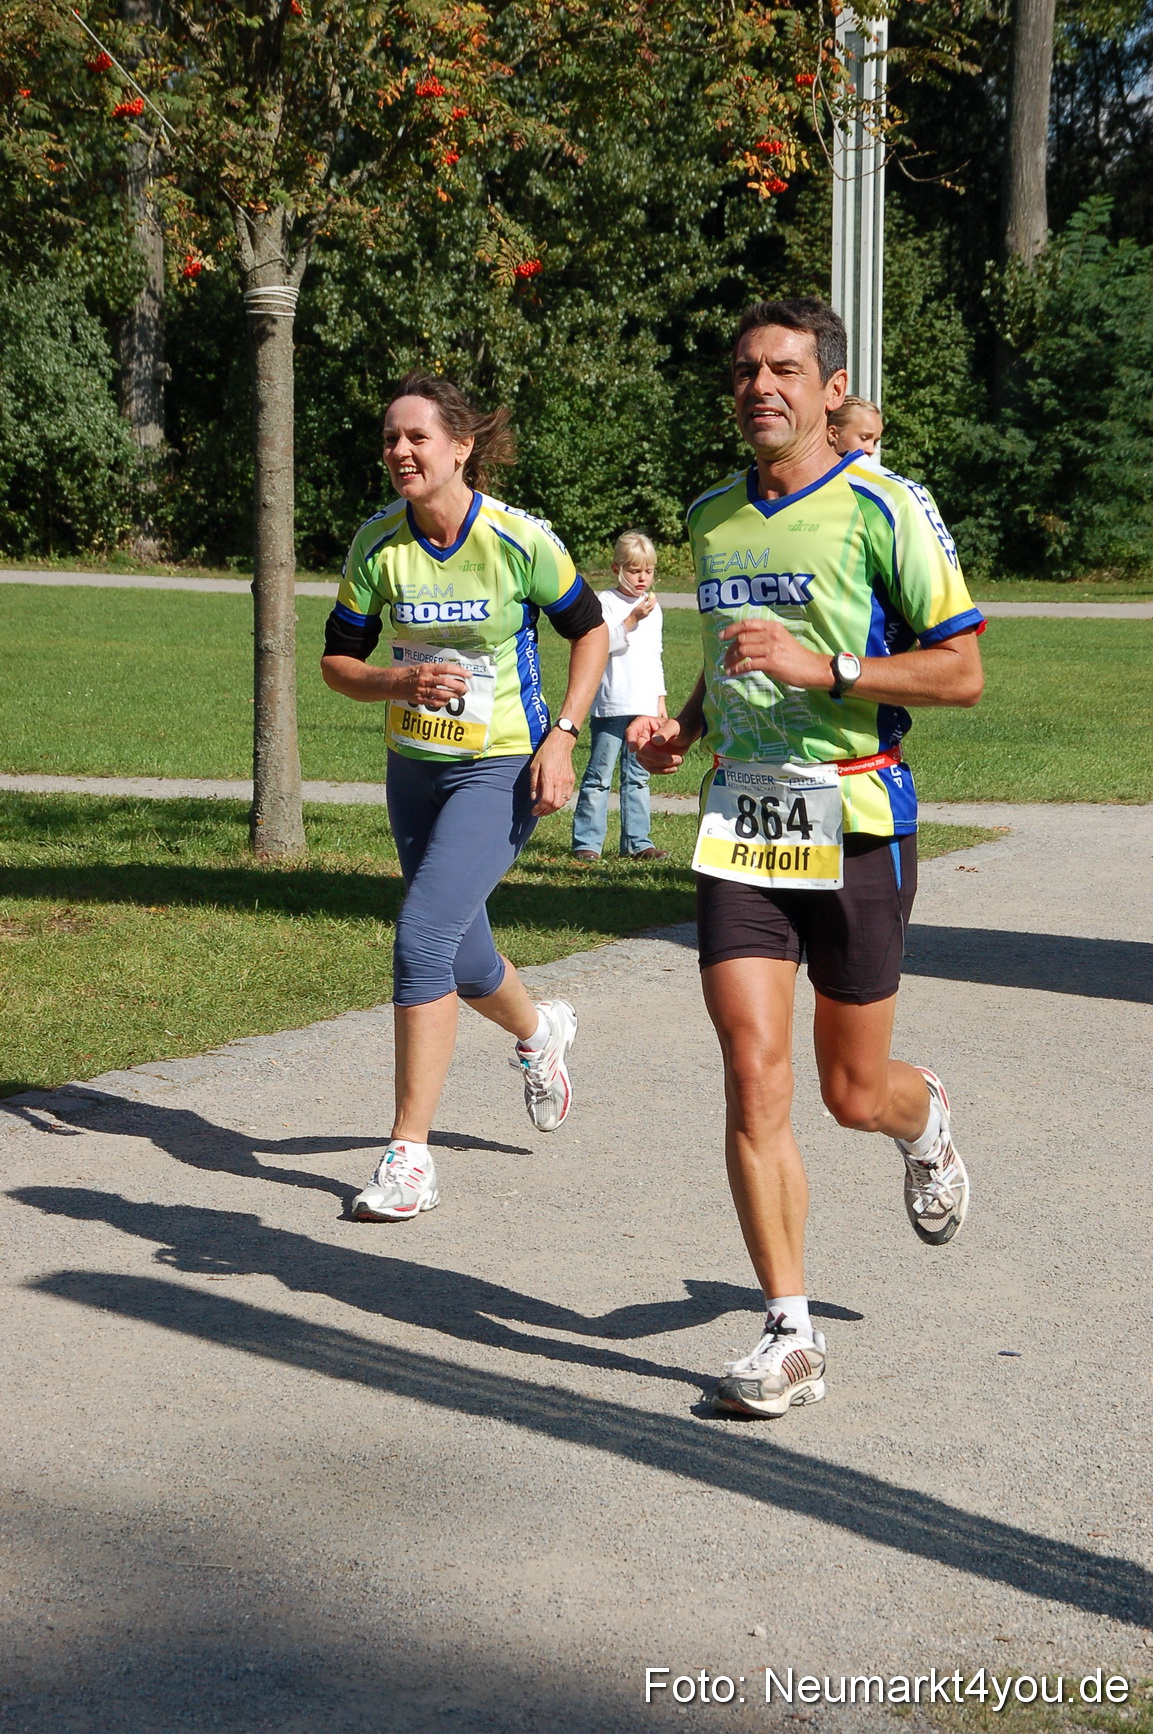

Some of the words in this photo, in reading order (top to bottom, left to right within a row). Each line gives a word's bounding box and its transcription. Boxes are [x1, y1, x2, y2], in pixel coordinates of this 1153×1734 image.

[700, 547, 770, 576] TEAM
[394, 583, 454, 599] TEAM
[697, 572, 816, 614] BOCK
[393, 599, 491, 624] BOCK
[401, 710, 465, 742] Brigitte
[726, 770, 775, 786] PFLEIDERER
[735, 794, 813, 840] 864
[730, 843, 811, 871] Rudolf
